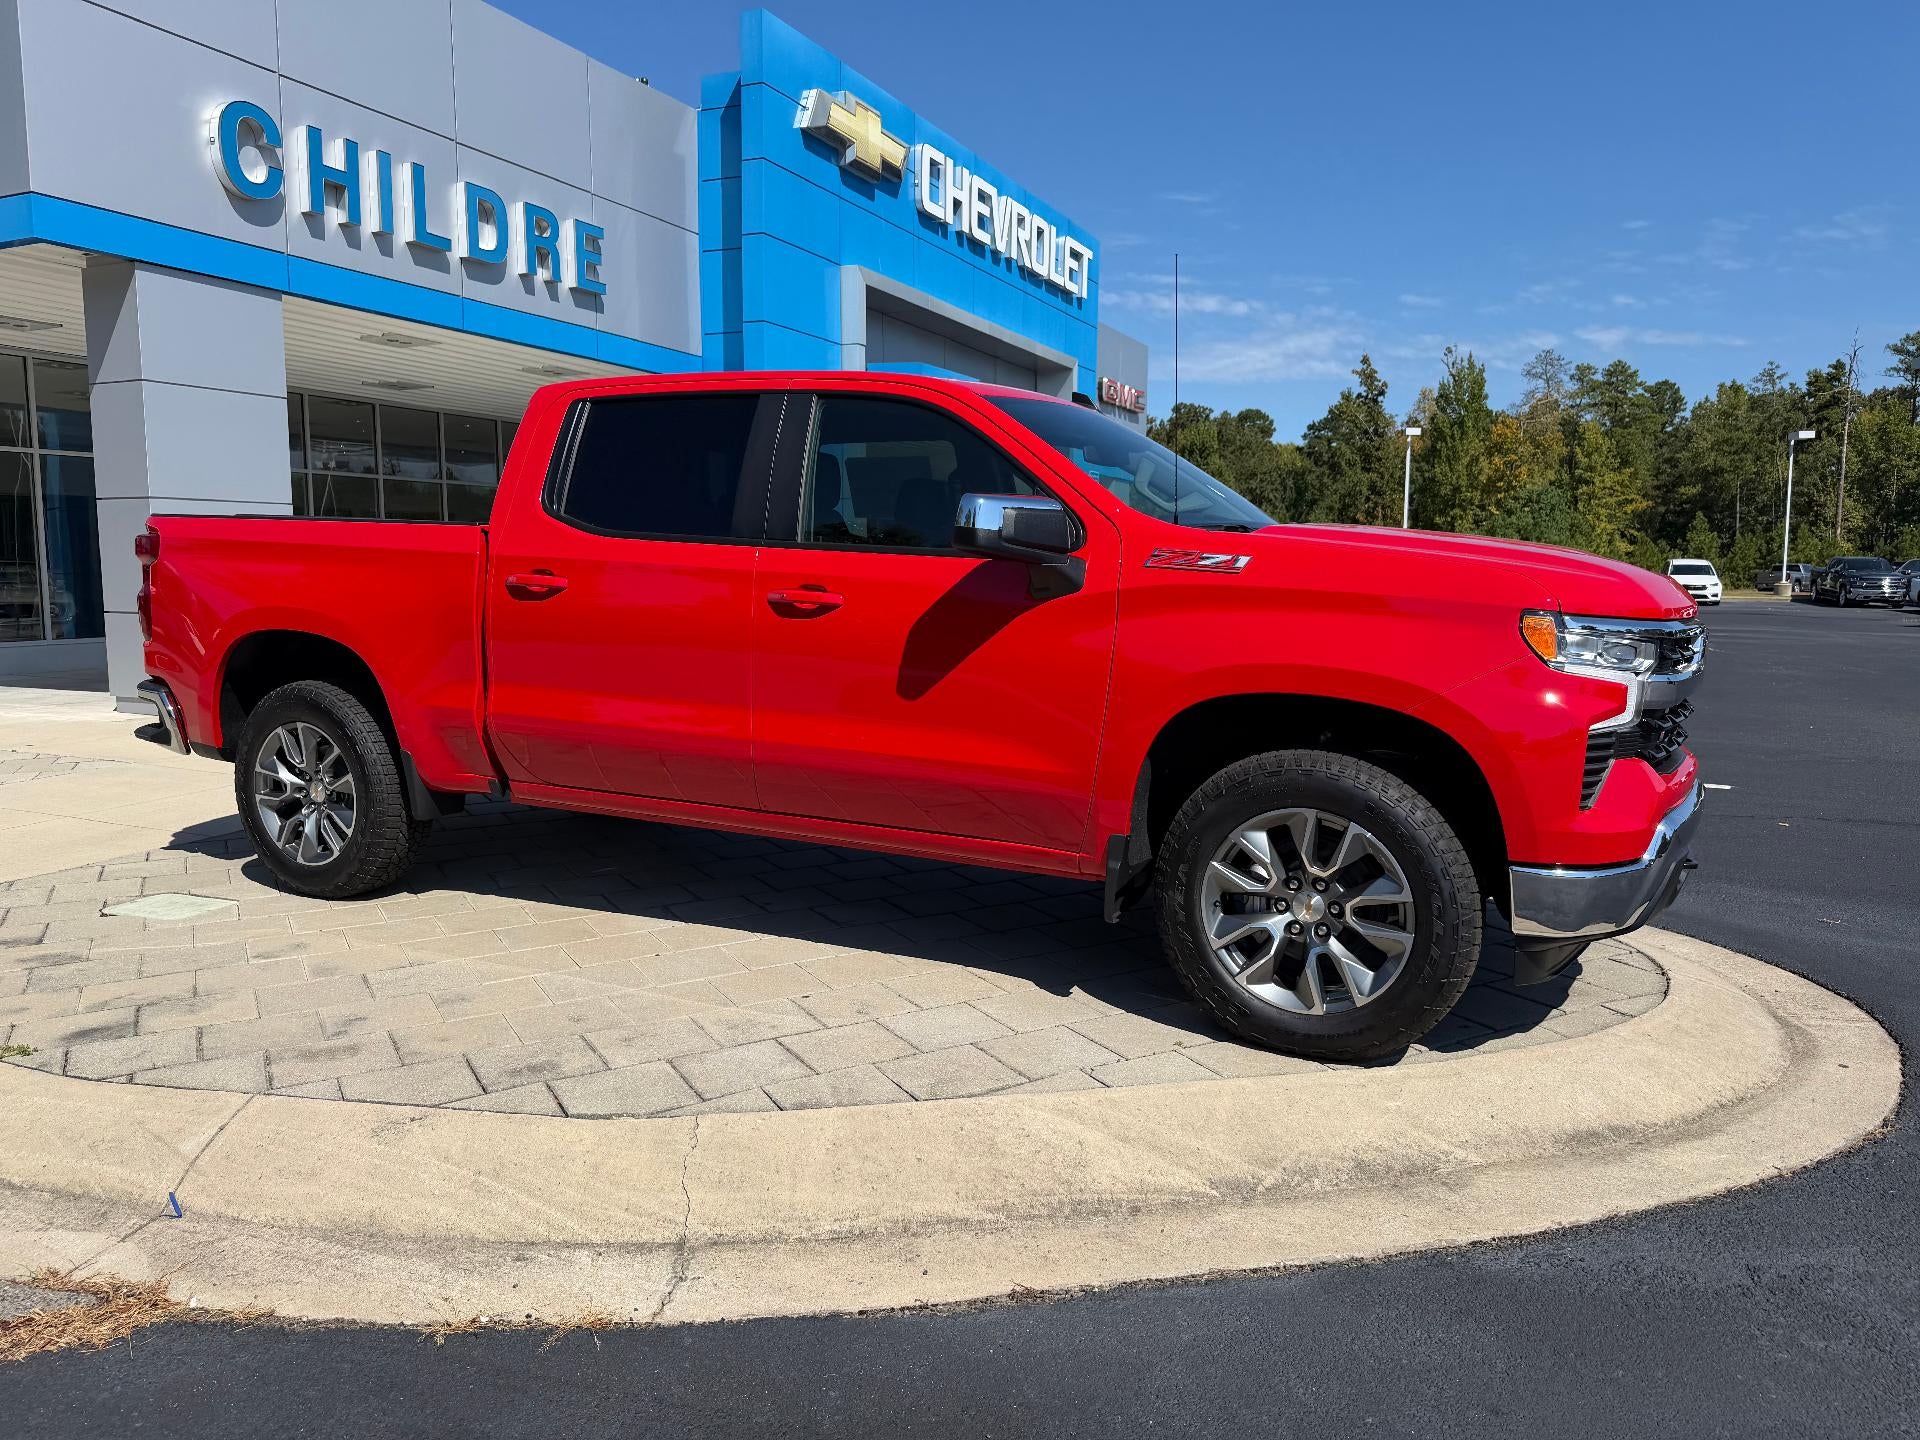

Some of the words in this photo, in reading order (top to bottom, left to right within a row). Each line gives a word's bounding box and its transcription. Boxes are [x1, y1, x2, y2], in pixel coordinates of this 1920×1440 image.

[209, 100, 607, 296] CHILDRE
[914, 143, 1093, 300] CHEVROLET
[1100, 377, 1145, 412] GMC
[1143, 547, 1252, 574] Z71
